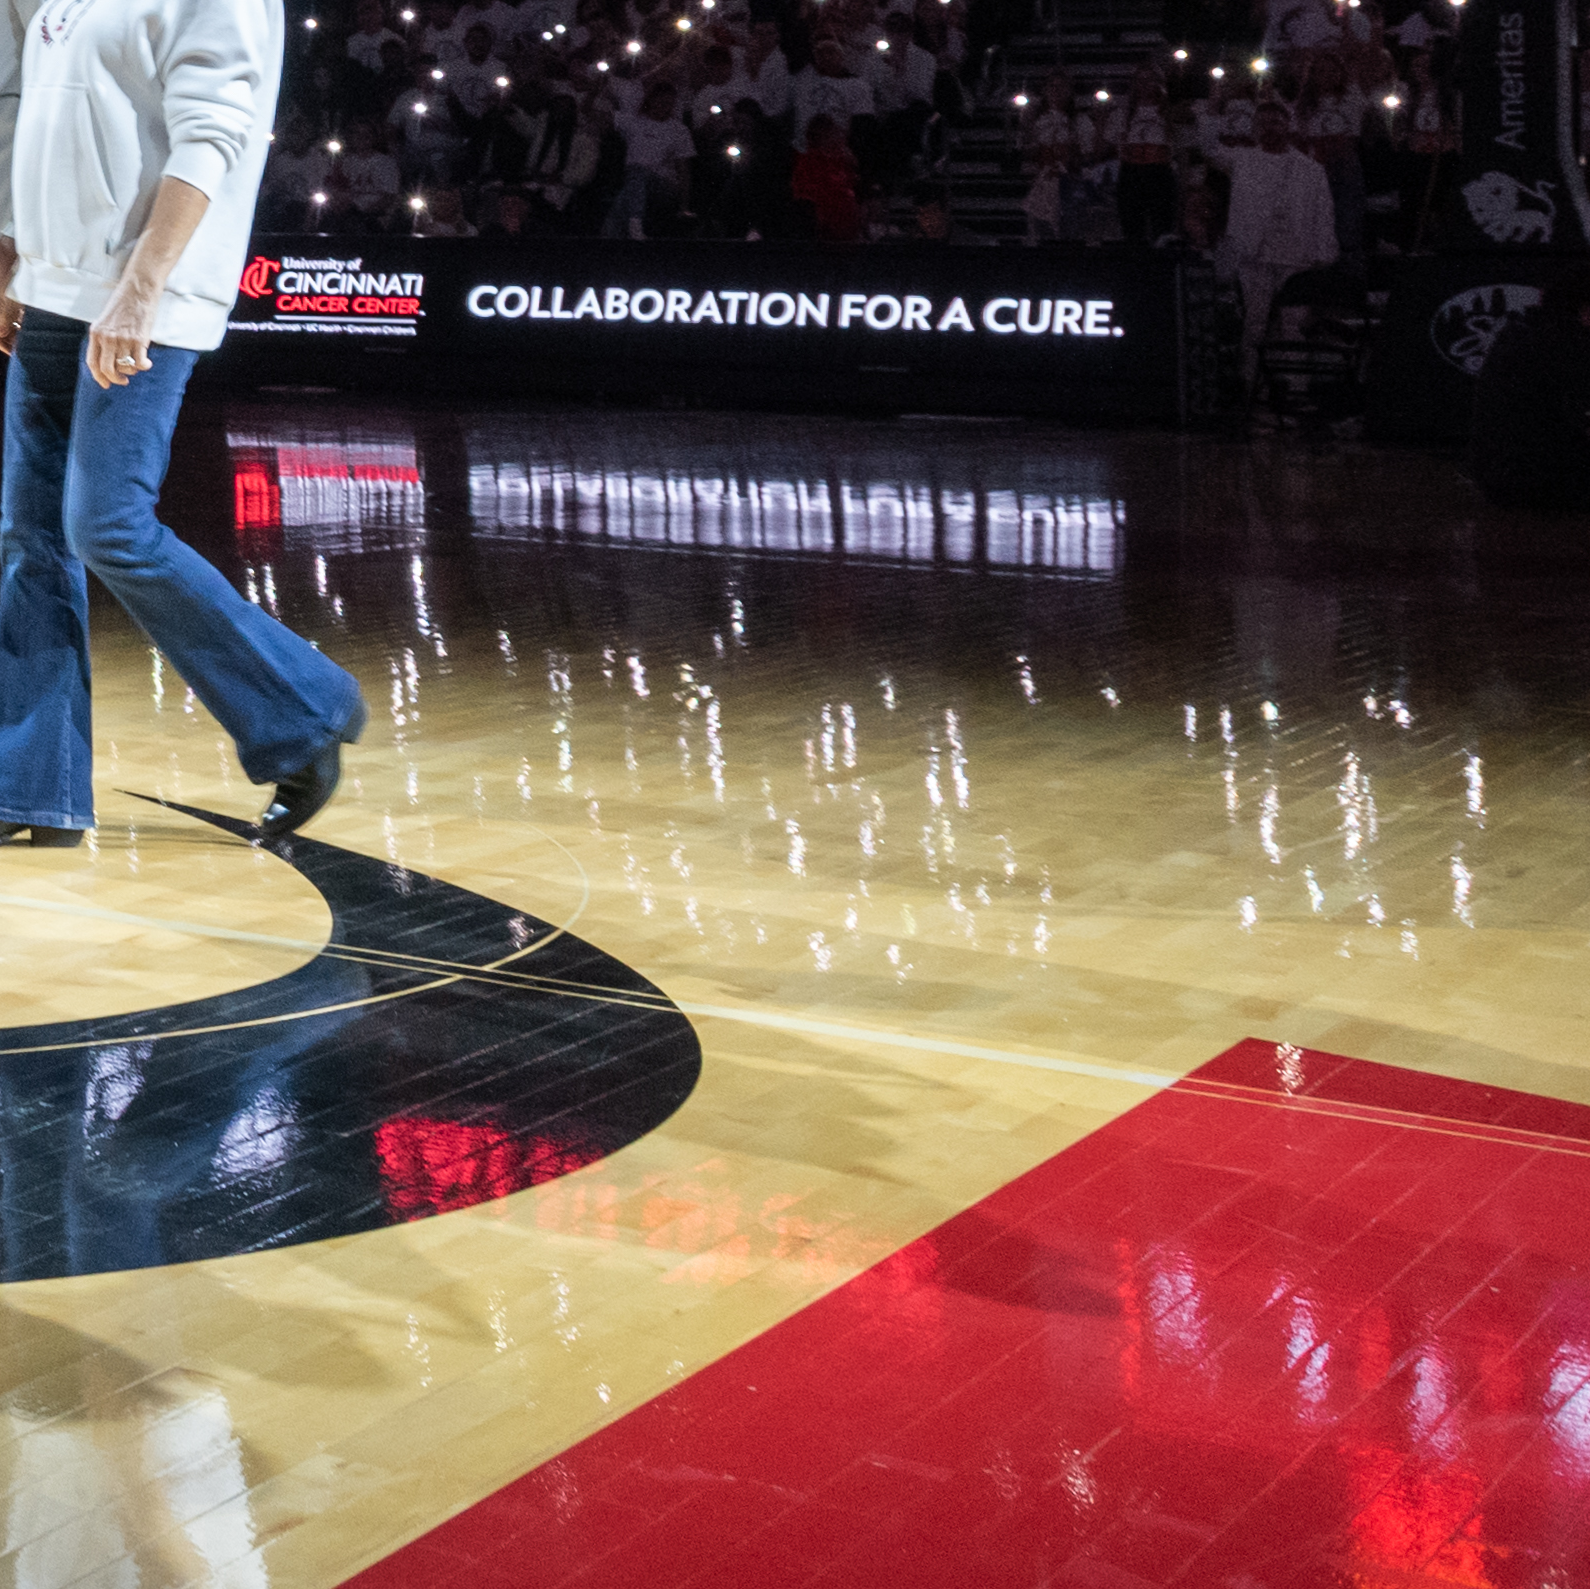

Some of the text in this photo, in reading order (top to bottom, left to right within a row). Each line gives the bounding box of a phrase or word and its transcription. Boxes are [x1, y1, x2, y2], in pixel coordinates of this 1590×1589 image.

[1495, 12, 1526, 151] Ameritas
[281, 256, 363, 273] University of
[276, 271, 424, 297] CINCINNATI
[275, 294, 421, 316] CANCER CENTER
[467, 285, 1124, 338] COLLABORATION FOR A CURE.
